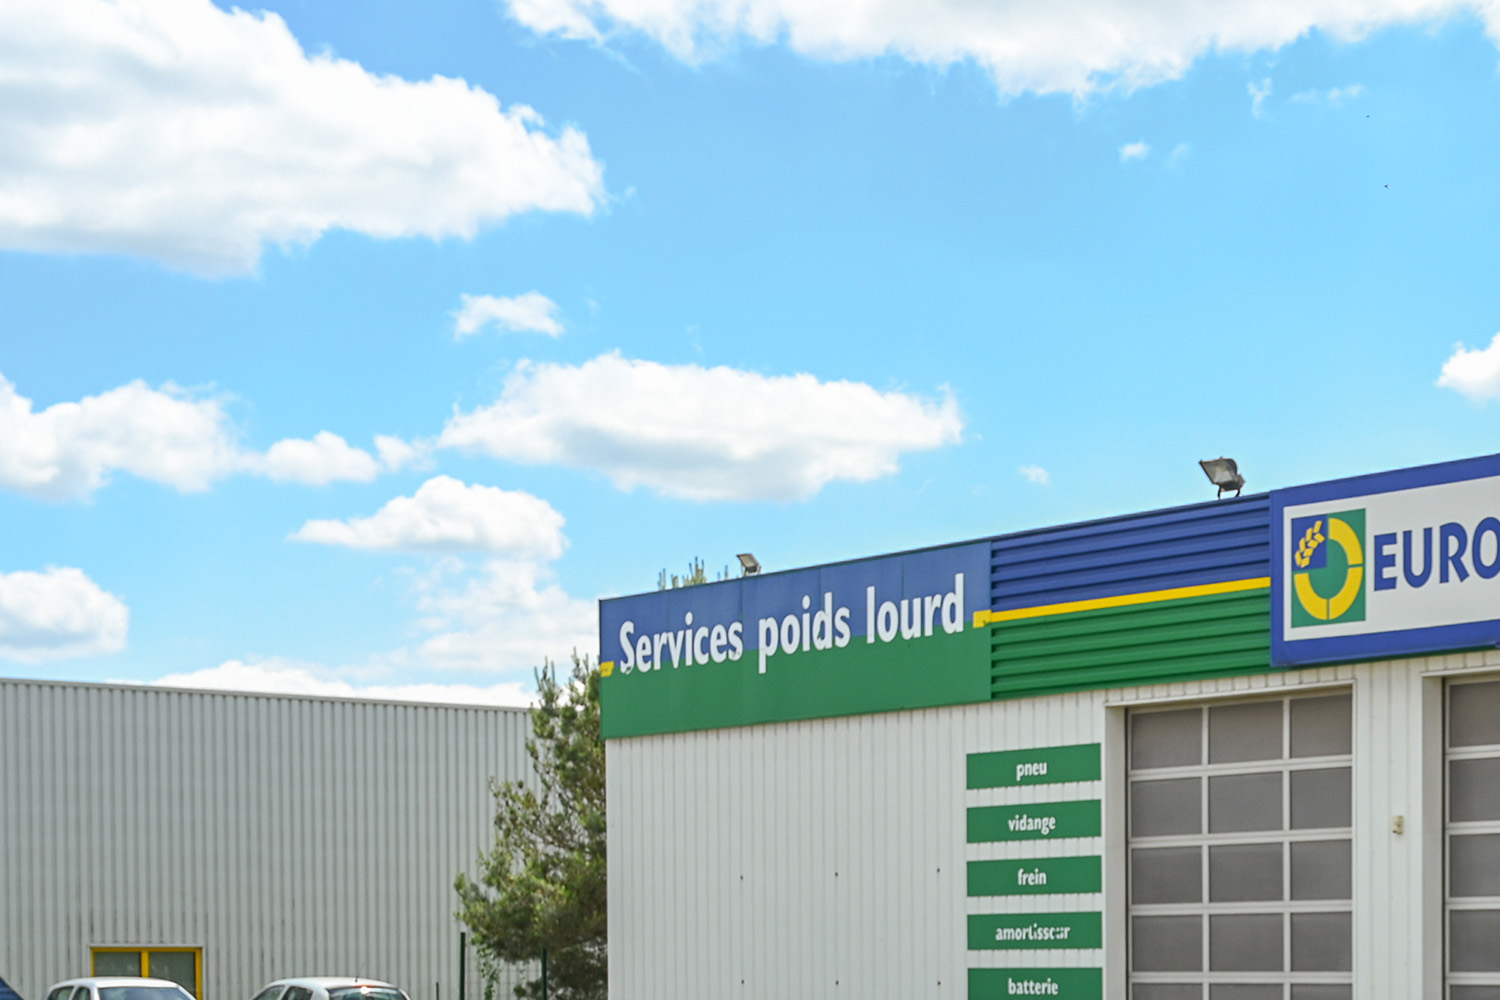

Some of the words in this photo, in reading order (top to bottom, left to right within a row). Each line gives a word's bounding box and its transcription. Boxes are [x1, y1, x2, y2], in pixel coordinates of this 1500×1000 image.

[619, 611, 743, 675] Services
[759, 591, 851, 674] poids
[866, 572, 964, 644] lourd
[1016, 762, 1048, 781] pneu
[1008, 814, 1056, 835] vidange
[1017, 868, 1047, 886] frein
[1008, 977, 1059, 995] batterie
